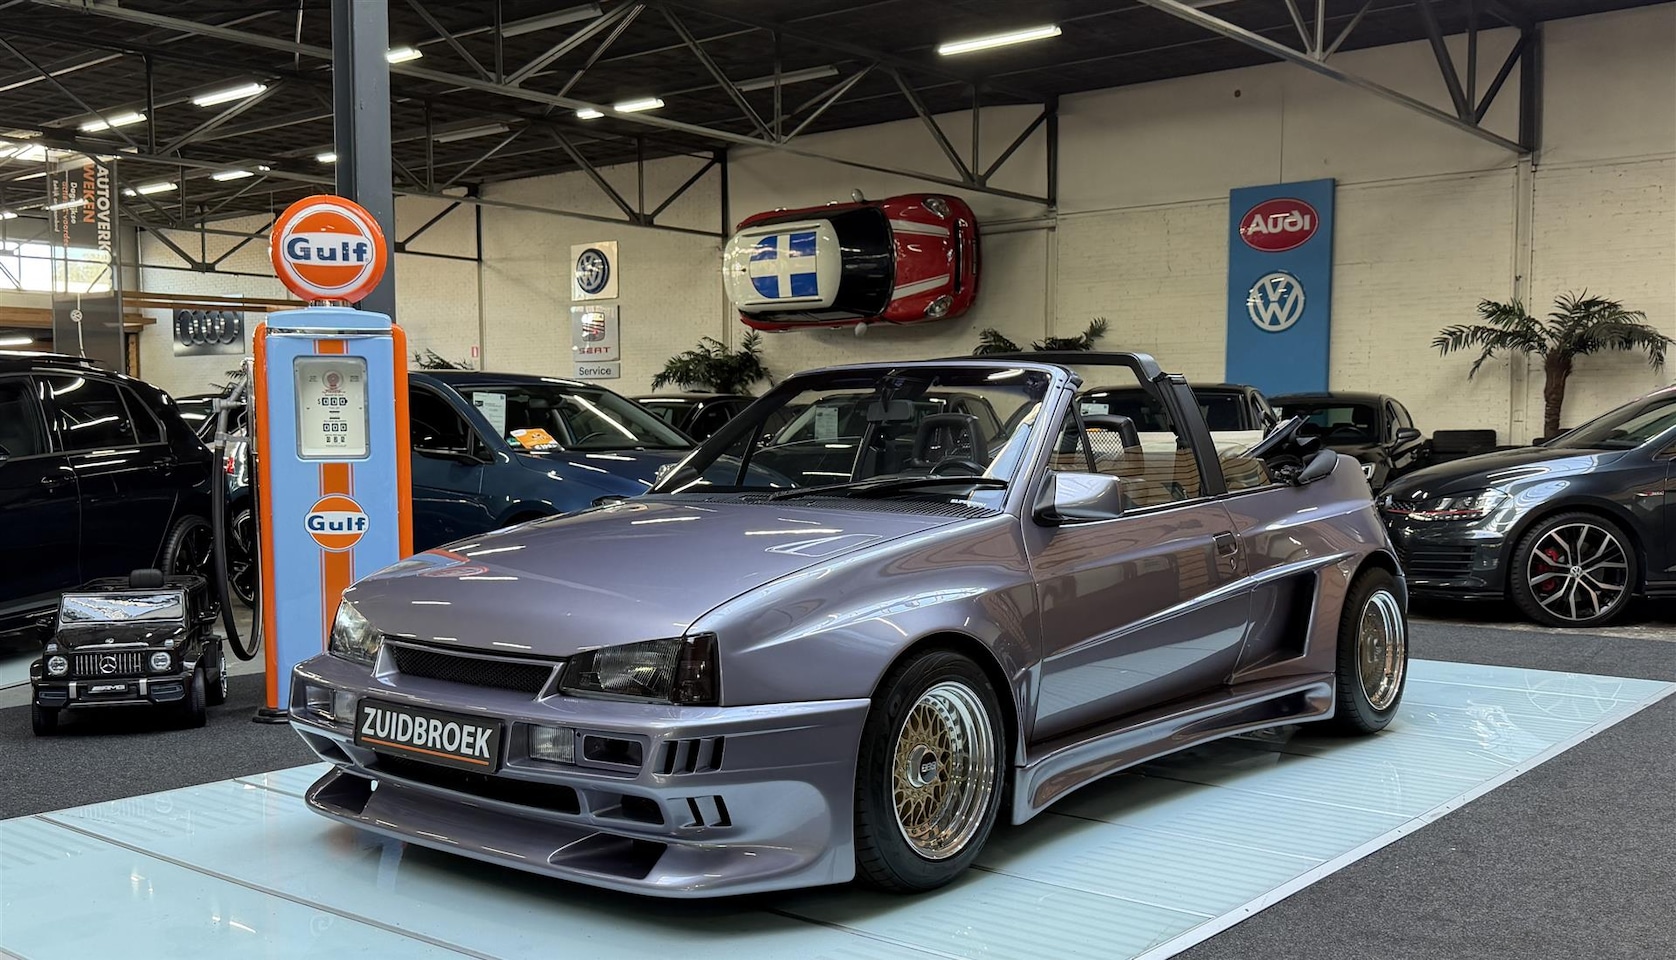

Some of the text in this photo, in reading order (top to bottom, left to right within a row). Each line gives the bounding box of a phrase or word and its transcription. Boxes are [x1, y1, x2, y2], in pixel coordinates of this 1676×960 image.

[69, 181, 78, 225] Dageijkse
[82, 162, 96, 224] WEKEN
[287, 237, 368, 262] Gulf
[579, 346, 611, 354] SEAT
[579, 366, 612, 376] Service
[307, 515, 366, 531] Gulf
[361, 706, 493, 759] ZUIDBROEK
